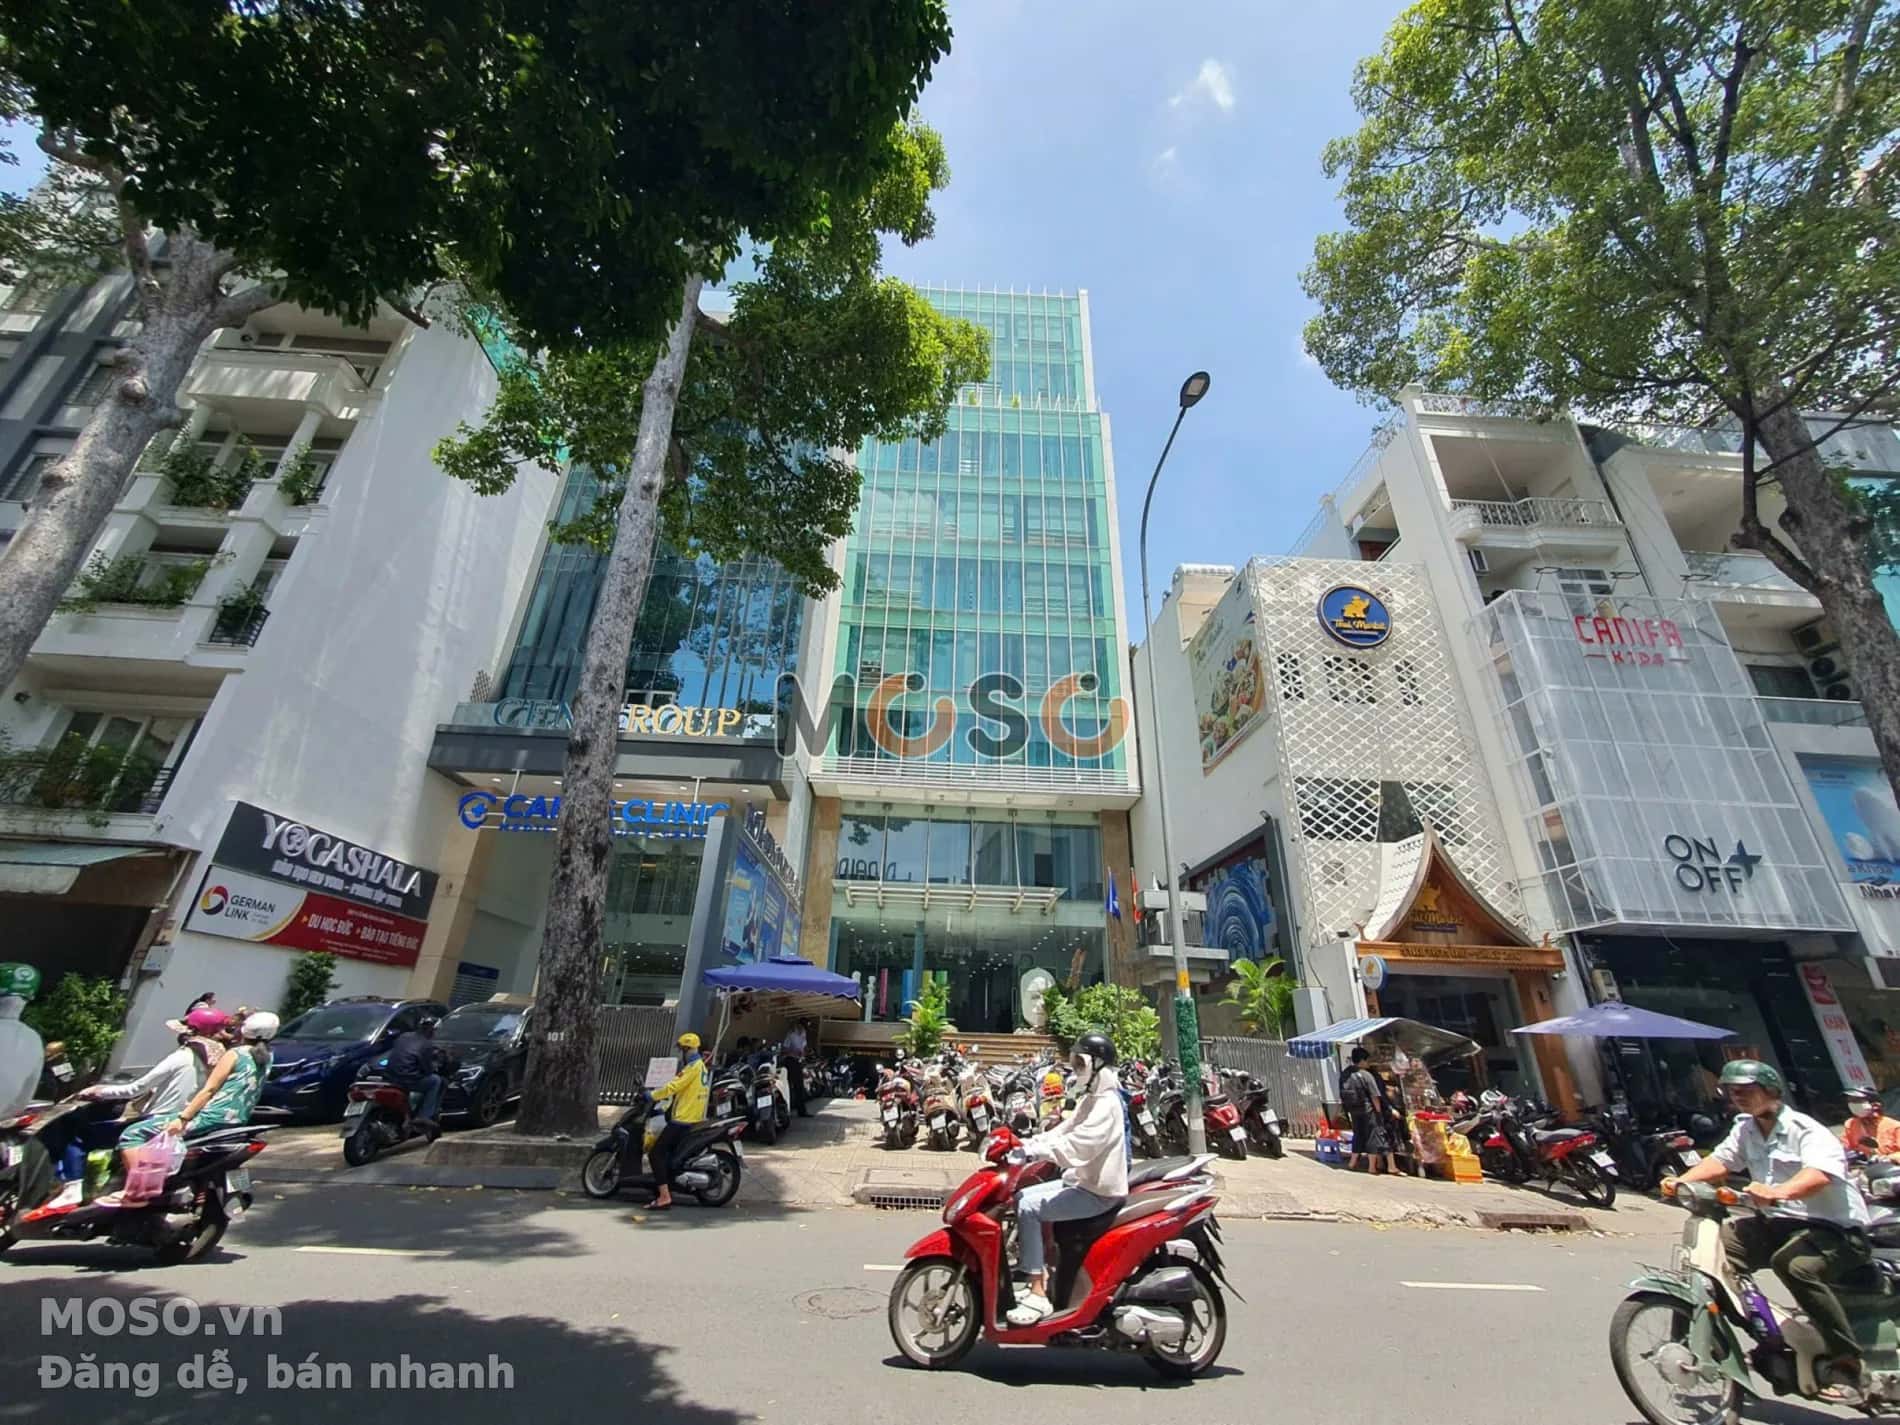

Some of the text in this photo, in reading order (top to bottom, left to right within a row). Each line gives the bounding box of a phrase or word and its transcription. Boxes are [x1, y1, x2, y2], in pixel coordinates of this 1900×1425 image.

[1574, 615, 1683, 648] CANIFA
[621, 703, 741, 737] ROUP
[1664, 834, 1721, 863] ON
[1676, 863, 1743, 893] OFF
[224, 906, 249, 921] LINK
[230, 895, 276, 913] GERMAN
